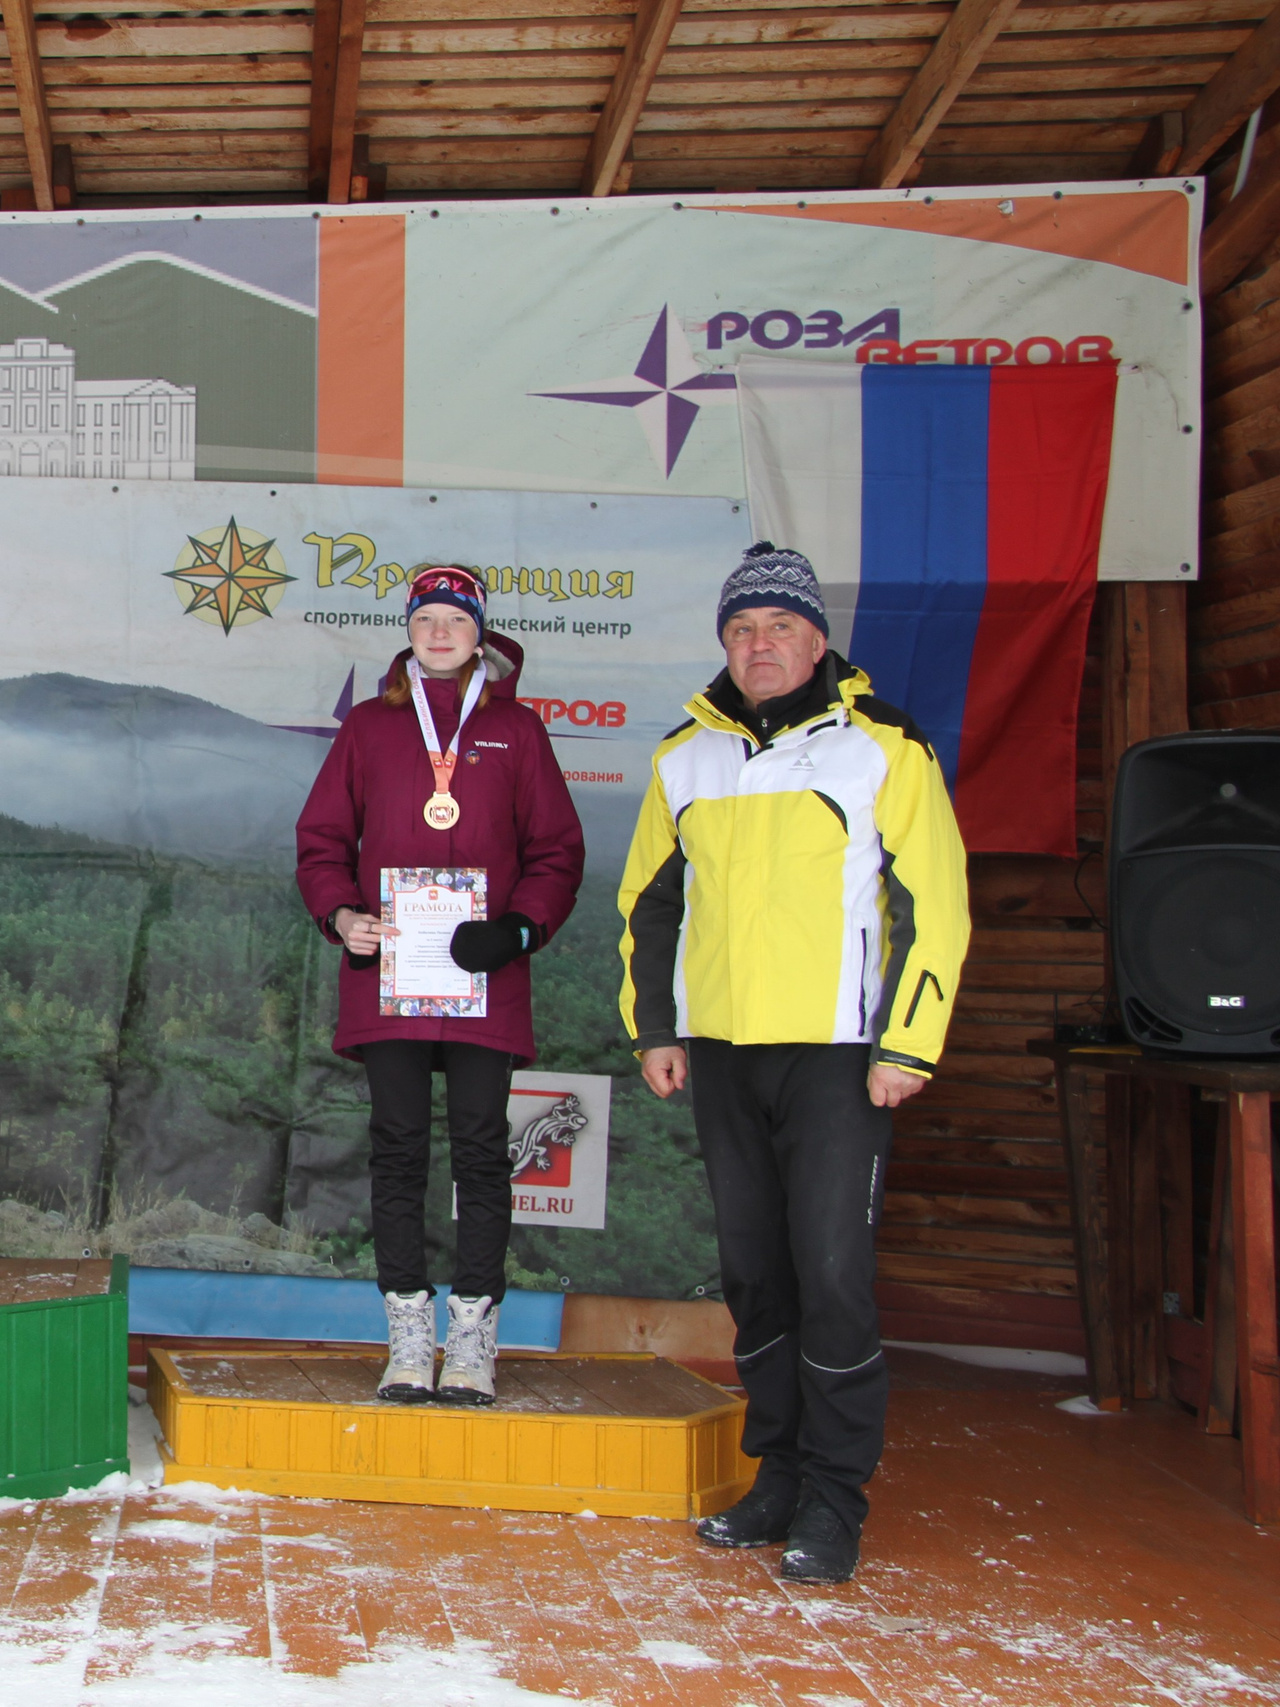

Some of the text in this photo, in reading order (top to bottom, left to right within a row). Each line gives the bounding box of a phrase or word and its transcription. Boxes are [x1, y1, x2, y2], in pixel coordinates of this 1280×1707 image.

[707, 308, 900, 349] РОЗА
[572, 620, 632, 639] центр
[404, 902, 463, 913] ГРАМОТА
[1210, 996, 1241, 1007] B&G
